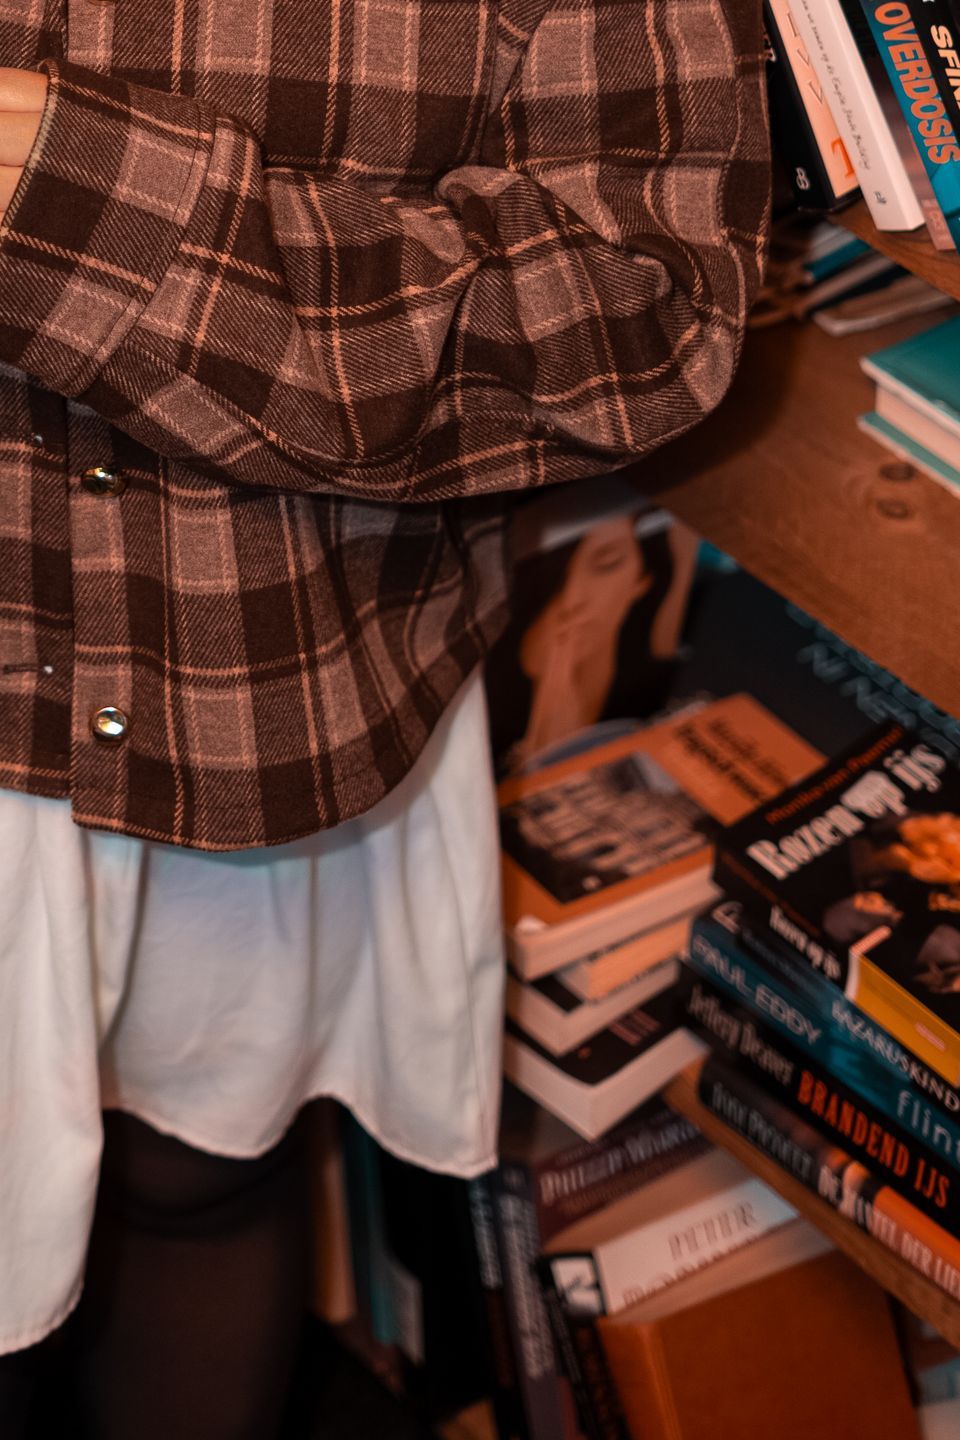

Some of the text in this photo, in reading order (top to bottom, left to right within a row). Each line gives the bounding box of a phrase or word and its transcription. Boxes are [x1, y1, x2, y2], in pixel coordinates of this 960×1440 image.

[874, 3, 959, 165] OVERDOSIS
[746, 805, 866, 881] Rozen
[755, 985, 823, 1046] EDDY
[797, 1070, 910, 1177] BRANDEND
[914, 1159, 950, 1209] IJS
